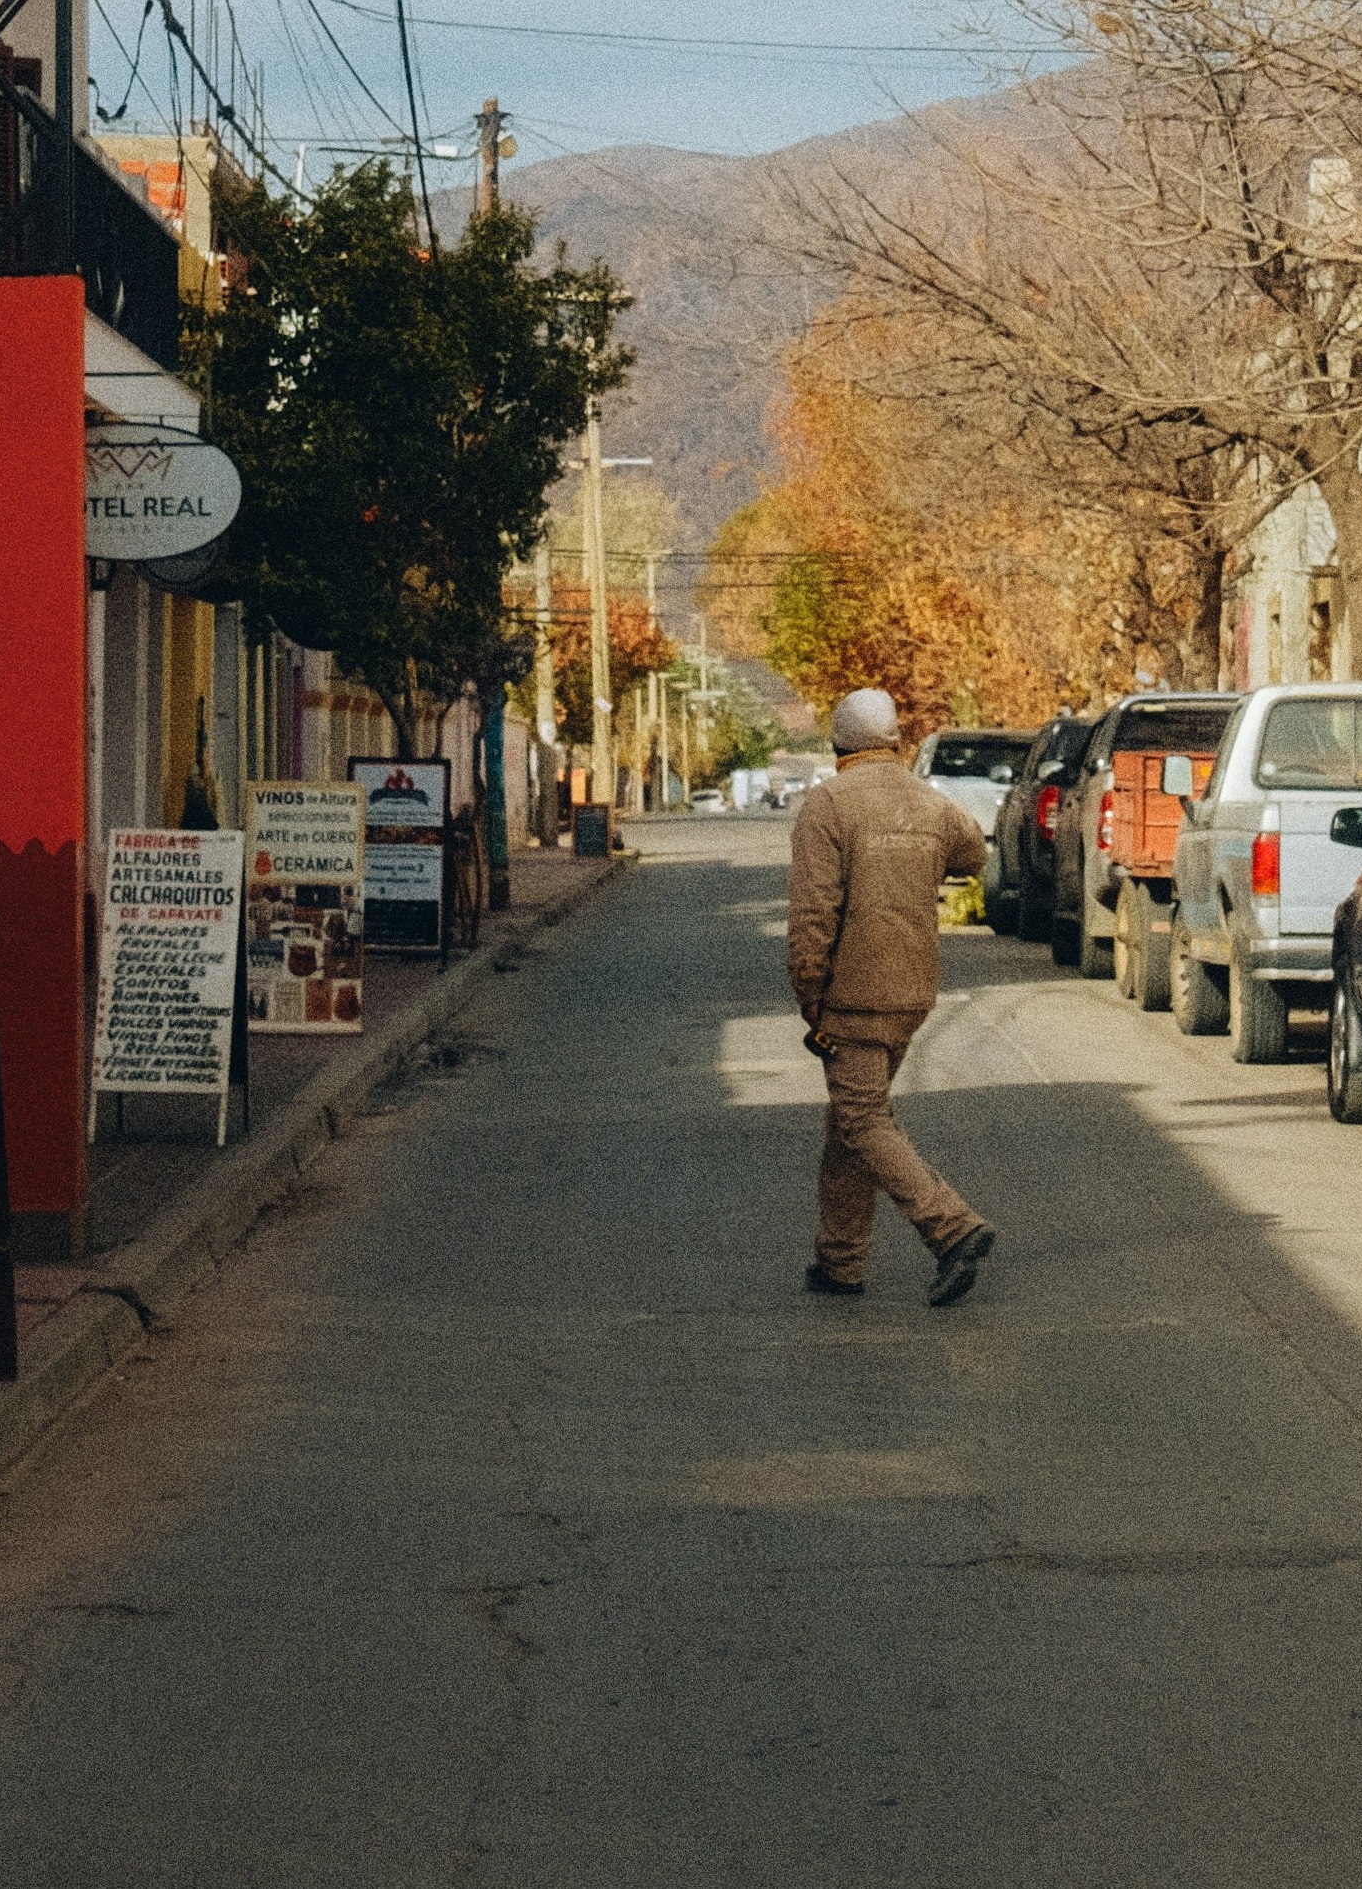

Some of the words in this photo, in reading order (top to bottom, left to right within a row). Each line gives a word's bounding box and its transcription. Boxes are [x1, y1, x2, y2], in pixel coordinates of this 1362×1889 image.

[84, 496, 135, 519] TEL
[143, 496, 212, 517] REAL
[255, 792, 305, 805] VINOS
[320, 793, 357, 806] Altura
[256, 831, 290, 842] ARTE
[292, 833, 310, 843] en
[311, 831, 357, 844] CUERO
[112, 852, 202, 867] ALFAJORES
[111, 868, 224, 884] ARTESANALES
[109, 885, 235, 906] CALCHAQUITOS
[120, 908, 140, 919] DE
[115, 924, 209, 938] ALFAJORES
[114, 964, 207, 978] ESPECIALES
[112, 977, 191, 990] CONITOS
[107, 1030, 159, 1042] VINOS
